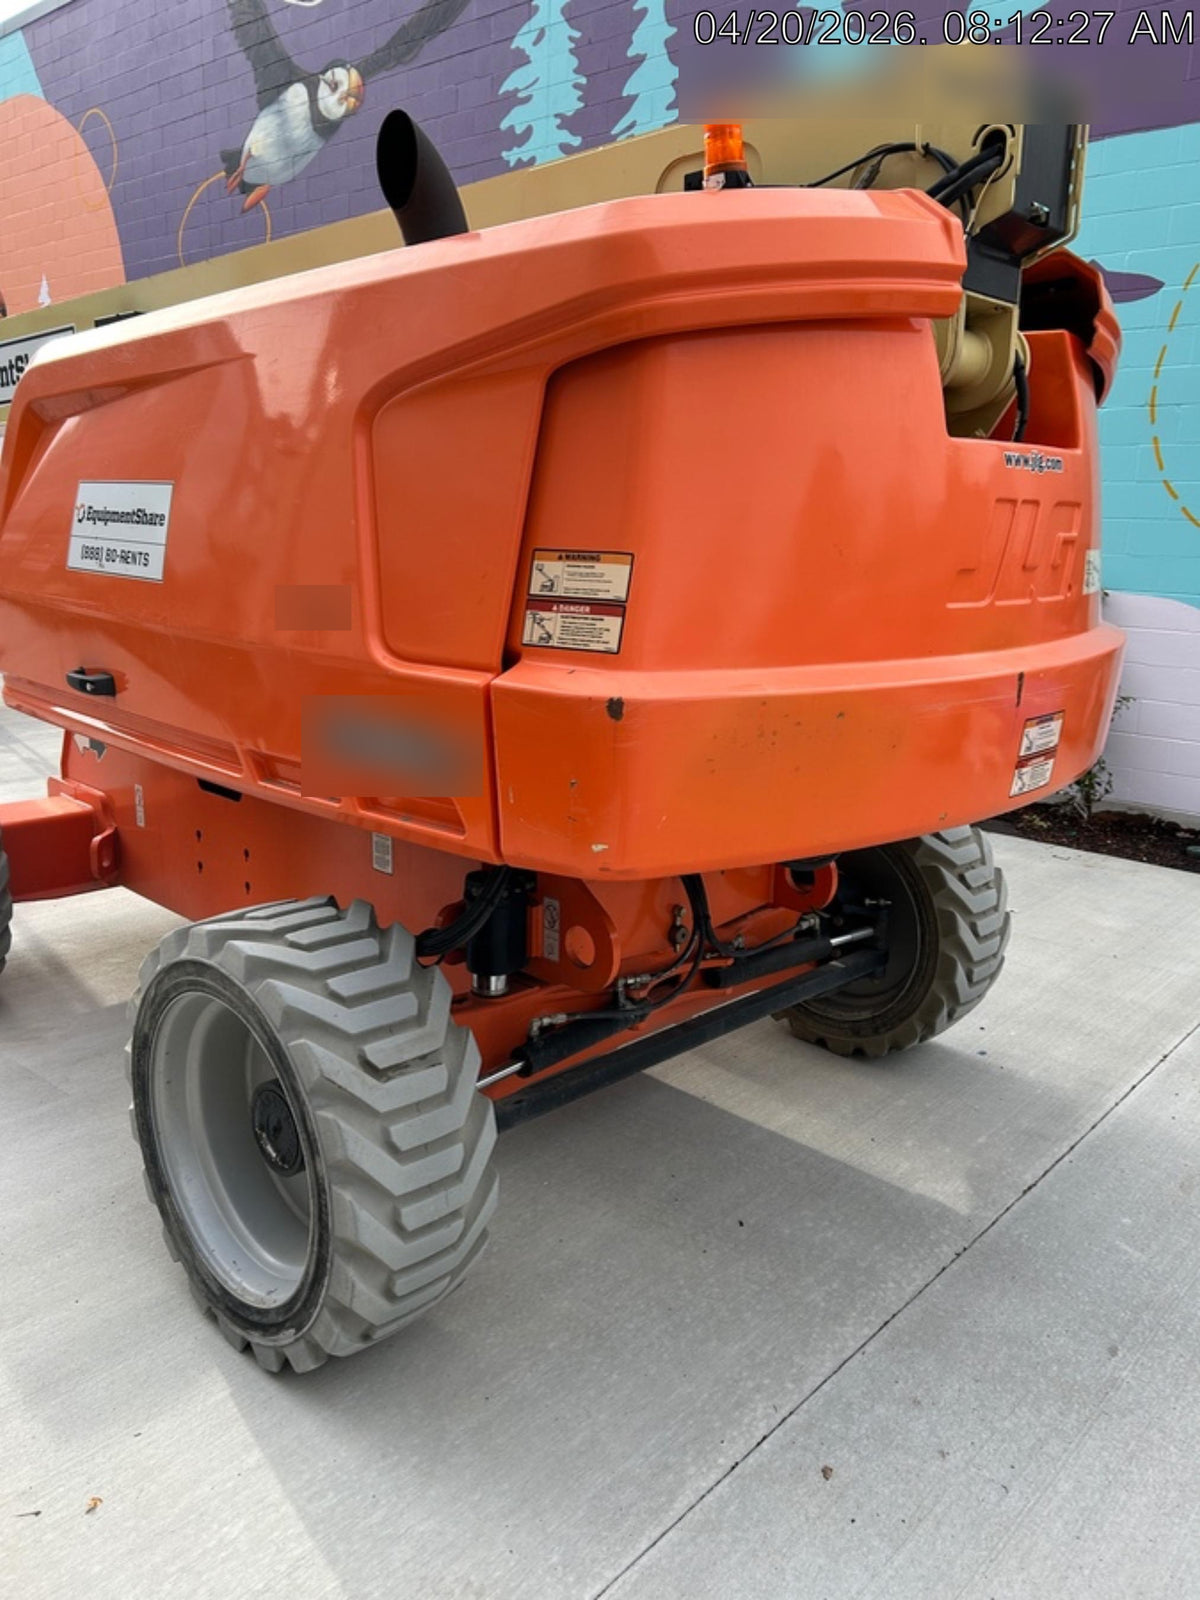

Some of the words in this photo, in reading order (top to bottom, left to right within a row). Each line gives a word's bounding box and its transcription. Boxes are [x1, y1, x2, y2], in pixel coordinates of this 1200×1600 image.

[1004, 450, 1063, 474] www.jlg.com
[86, 506, 166, 527] EquipmentShare
[81, 544, 104, 563] (888)
[564, 553, 601, 562] WARNING
[945, 498, 1082, 609] JLG
[559, 604, 591, 613] DANGER
